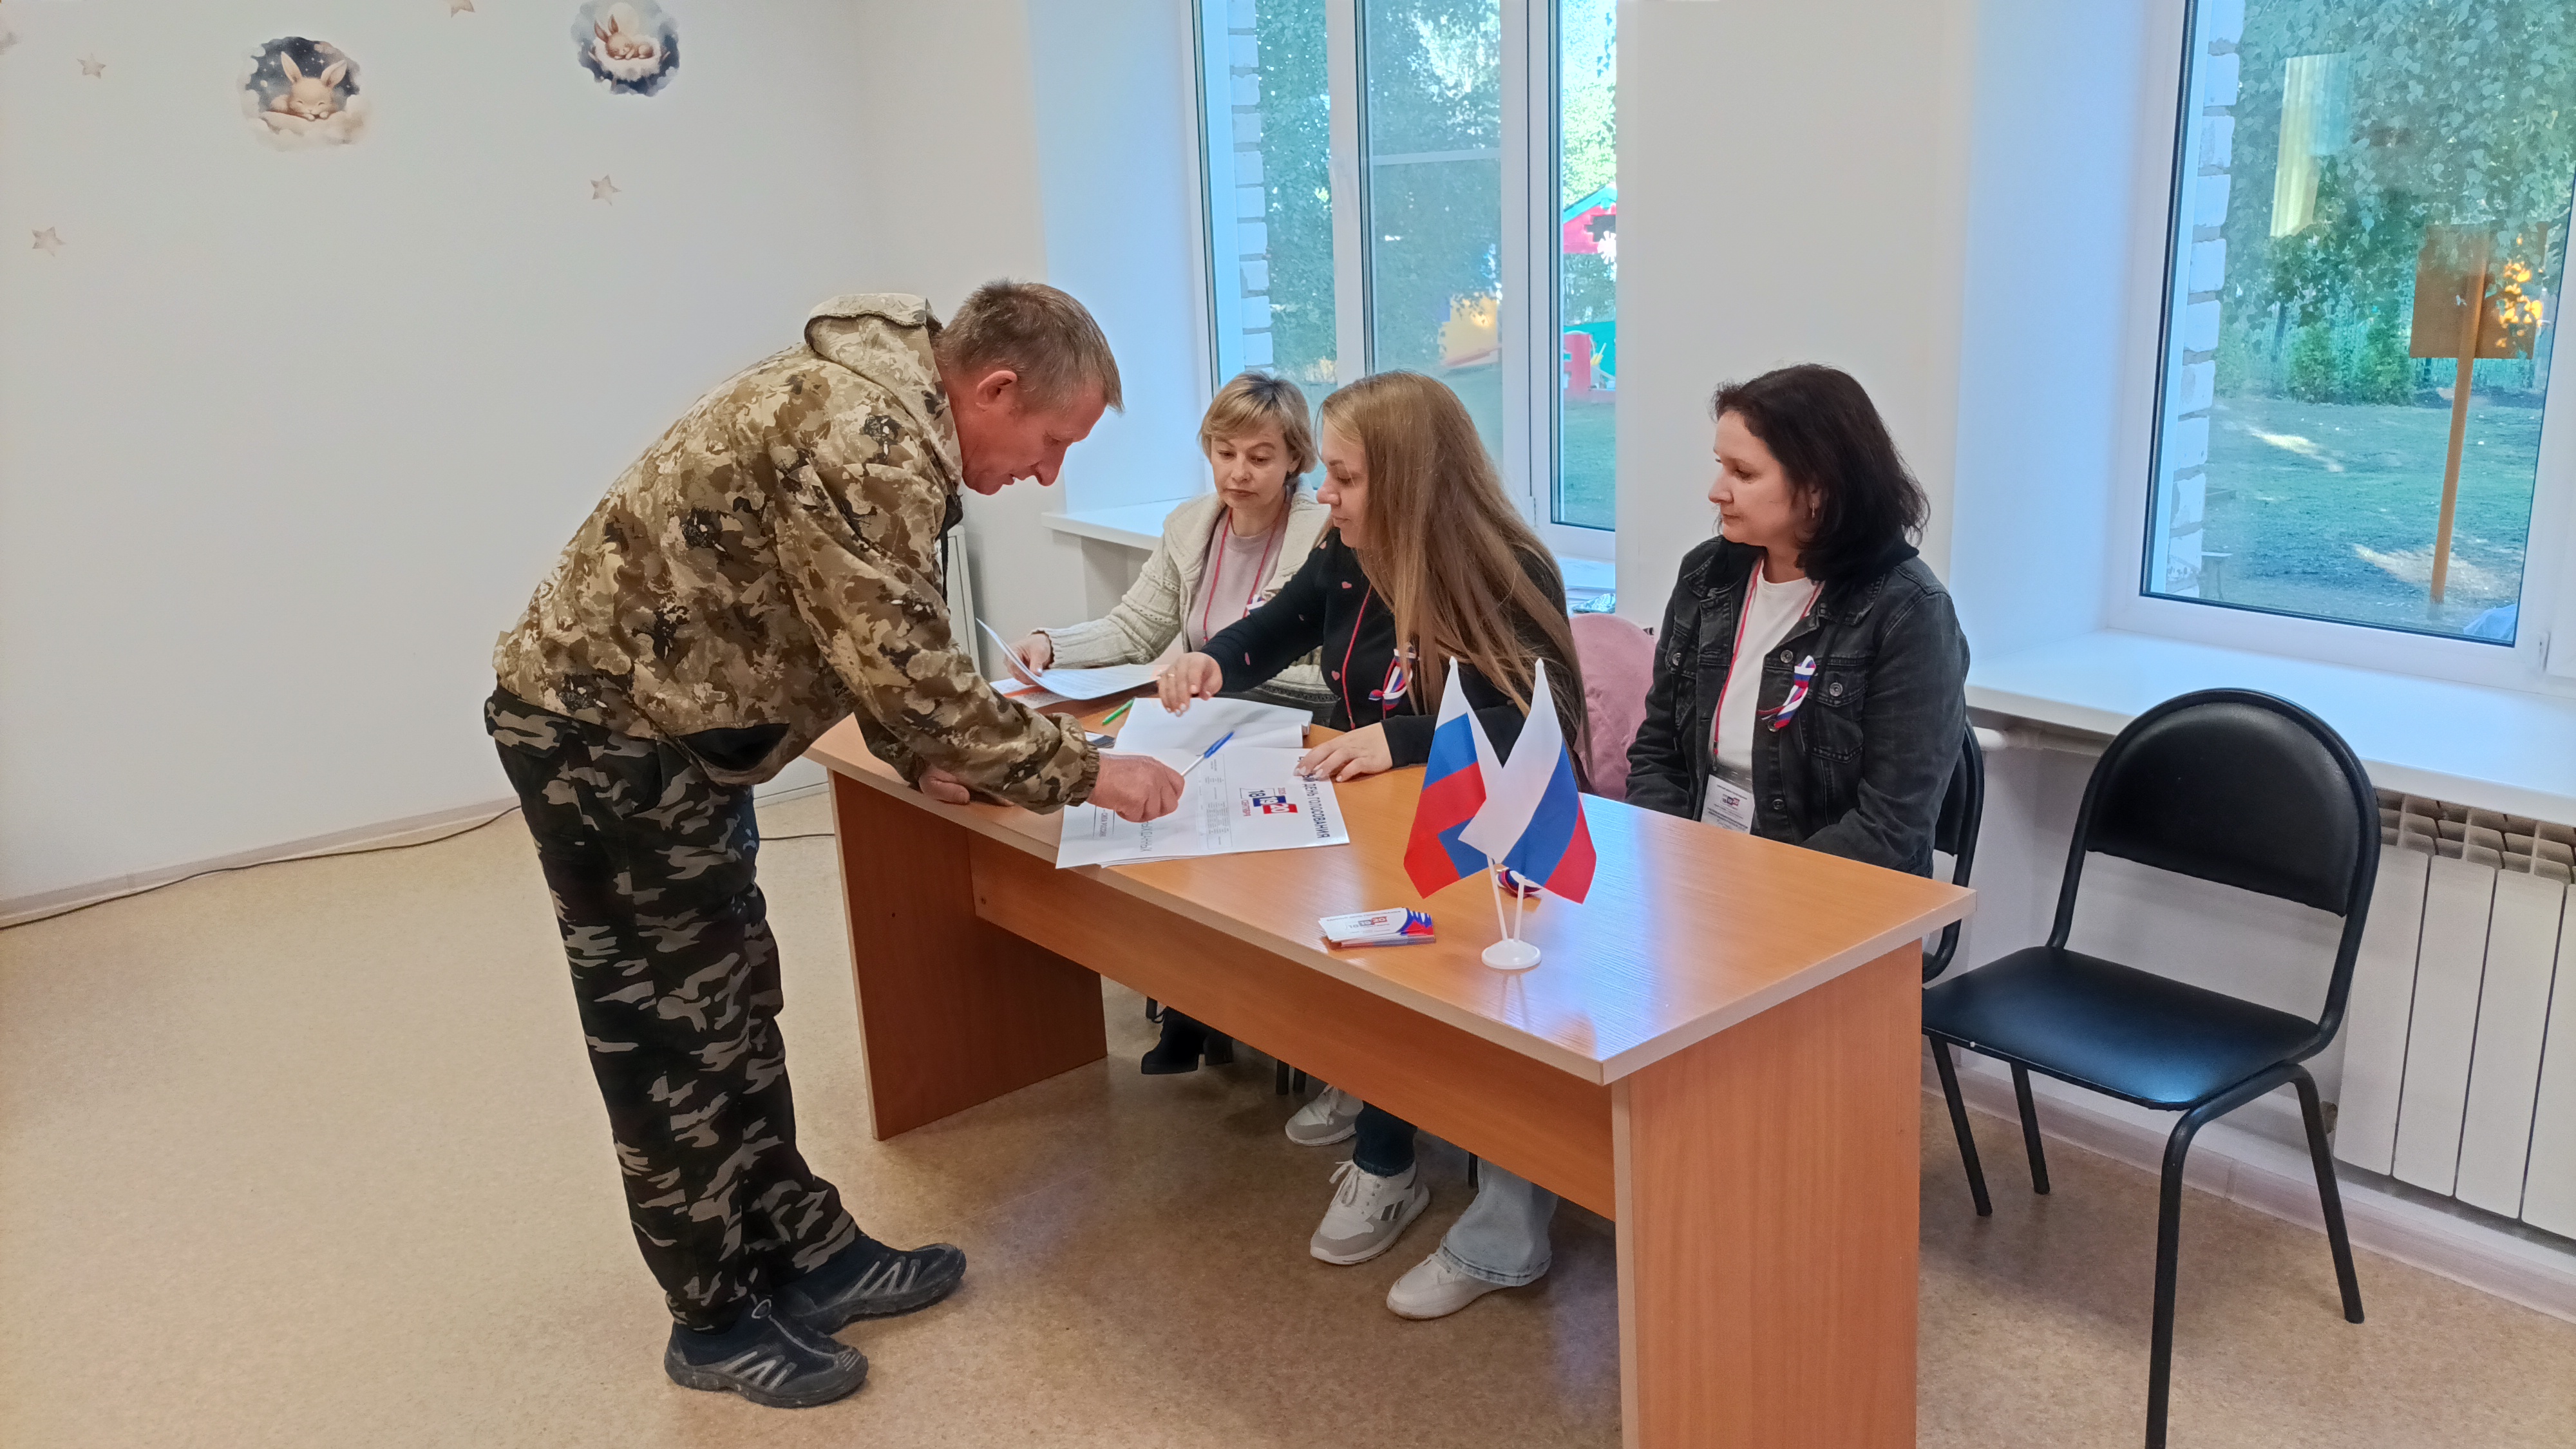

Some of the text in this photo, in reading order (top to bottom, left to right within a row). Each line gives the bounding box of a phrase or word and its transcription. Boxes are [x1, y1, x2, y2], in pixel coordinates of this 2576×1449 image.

[1302, 783, 1319, 797] ДЕНЬ
[1259, 796, 1278, 804] 19
[1270, 803, 1289, 813] 20
[1308, 797, 1331, 838] ГОЛОСОВАНИЯ
